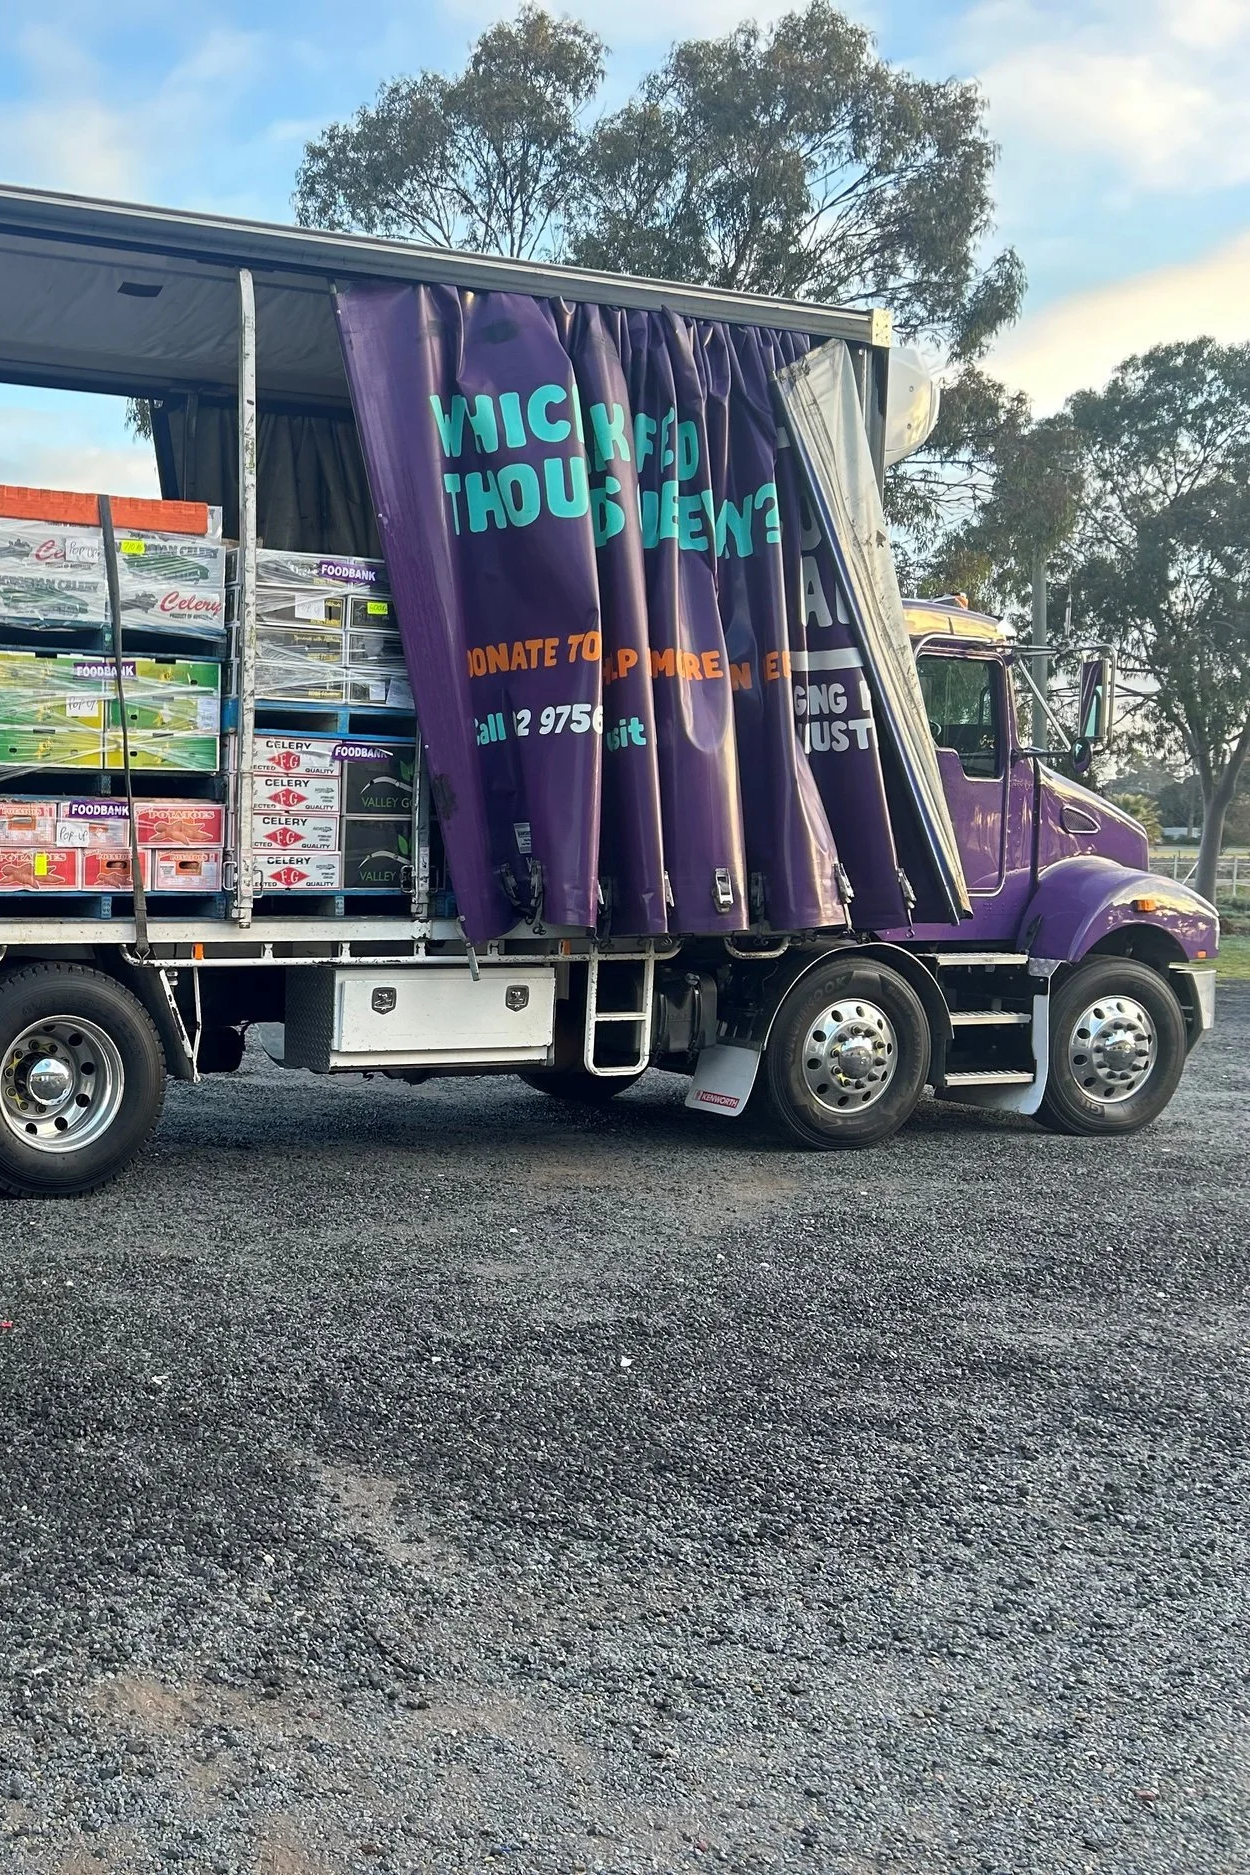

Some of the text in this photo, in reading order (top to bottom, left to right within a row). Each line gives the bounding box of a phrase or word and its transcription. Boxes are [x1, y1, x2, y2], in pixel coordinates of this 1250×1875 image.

[321, 564, 376, 582] FOODBANK
[160, 591, 222, 615] Celery
[567, 631, 601, 663] TO
[76, 665, 134, 677] FOODBANK
[475, 713, 507, 746] all
[265, 740, 312, 750] CELERY
[265, 778, 310, 788] CELERY
[361, 797, 399, 808] VALLEY
[71, 804, 129, 816] FOODBANK
[149, 810, 215, 819] POTATOES
[262, 816, 308, 827] CELERY
[267, 856, 311, 865] CELERY
[359, 871, 396, 881] VALLEY
[701, 1093, 739, 1107] KENWORTH
